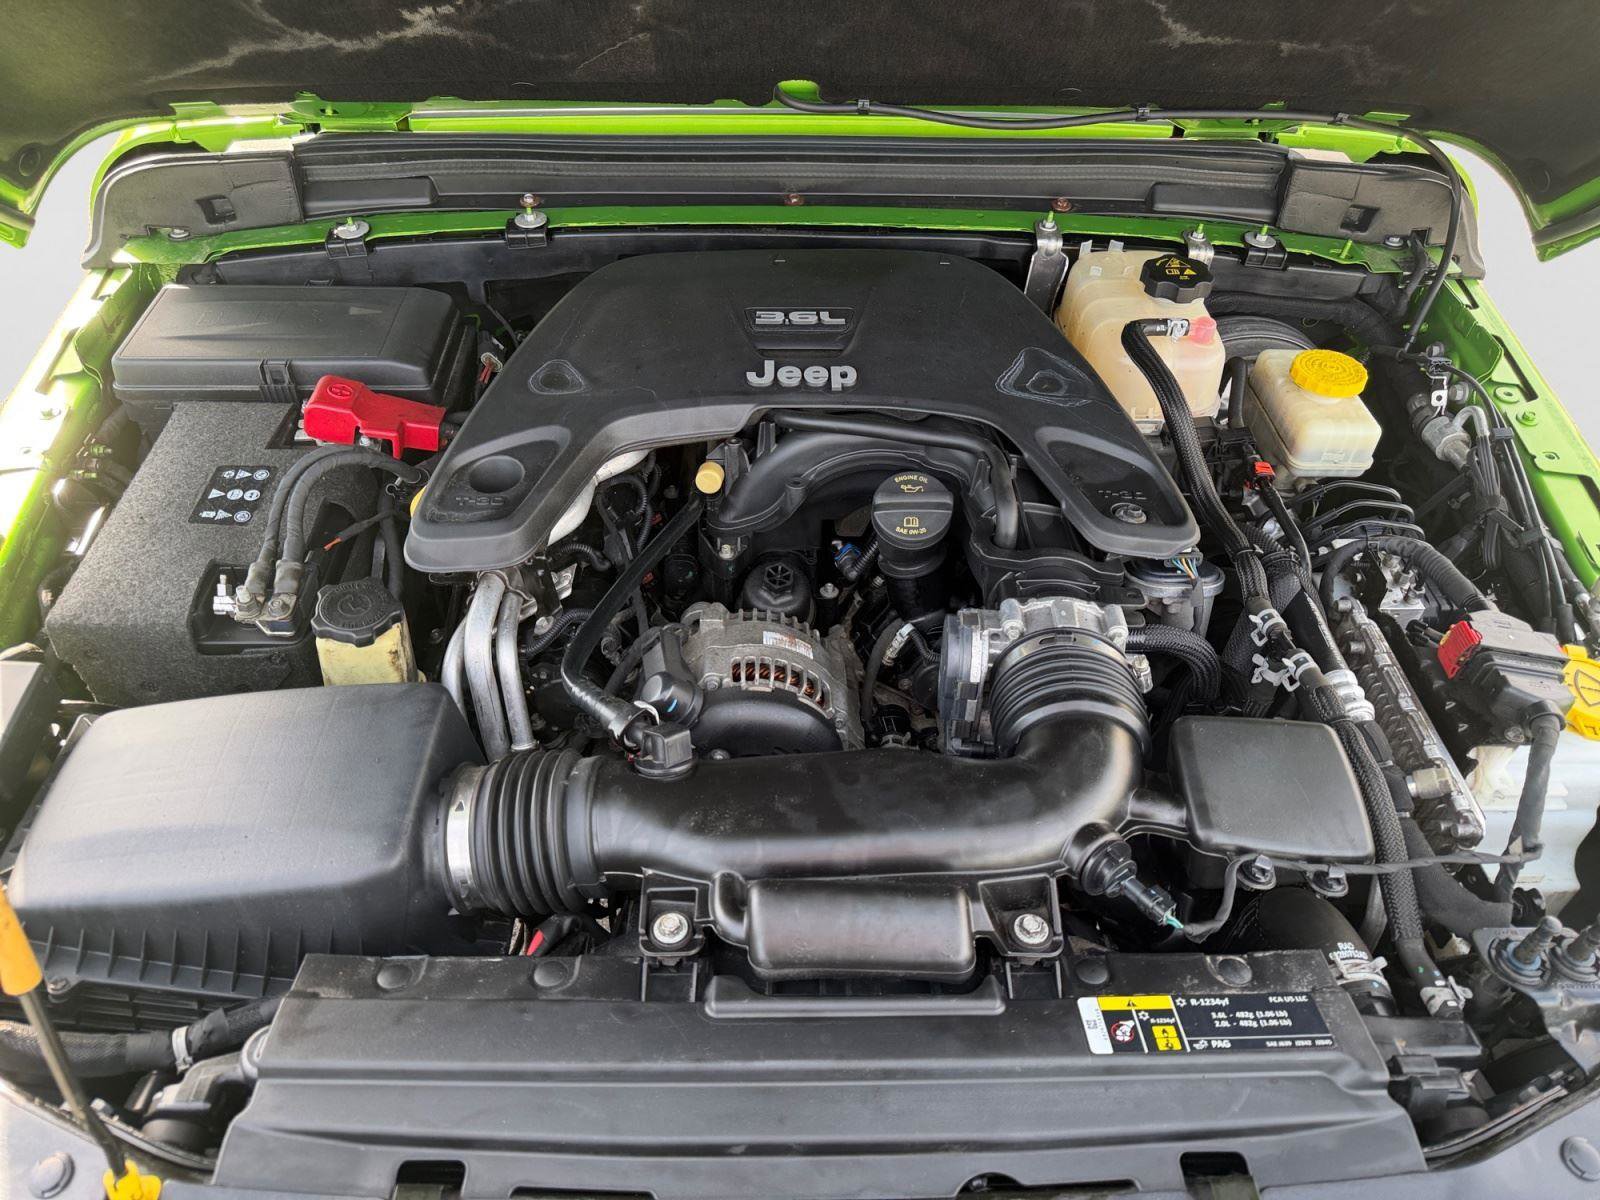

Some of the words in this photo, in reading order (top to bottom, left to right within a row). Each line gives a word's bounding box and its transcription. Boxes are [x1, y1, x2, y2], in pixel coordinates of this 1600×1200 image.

[755, 311, 846, 325] 3.6L
[746, 360, 858, 391] Jeep
[894, 475, 918, 483] ENGINE
[918, 475, 929, 483] OIL
[895, 526, 909, 535] SAE
[908, 527, 928, 535] 0W-20
[1190, 997, 1230, 1007] R-1234yf
[1210, 1040, 1232, 1048] PAG
